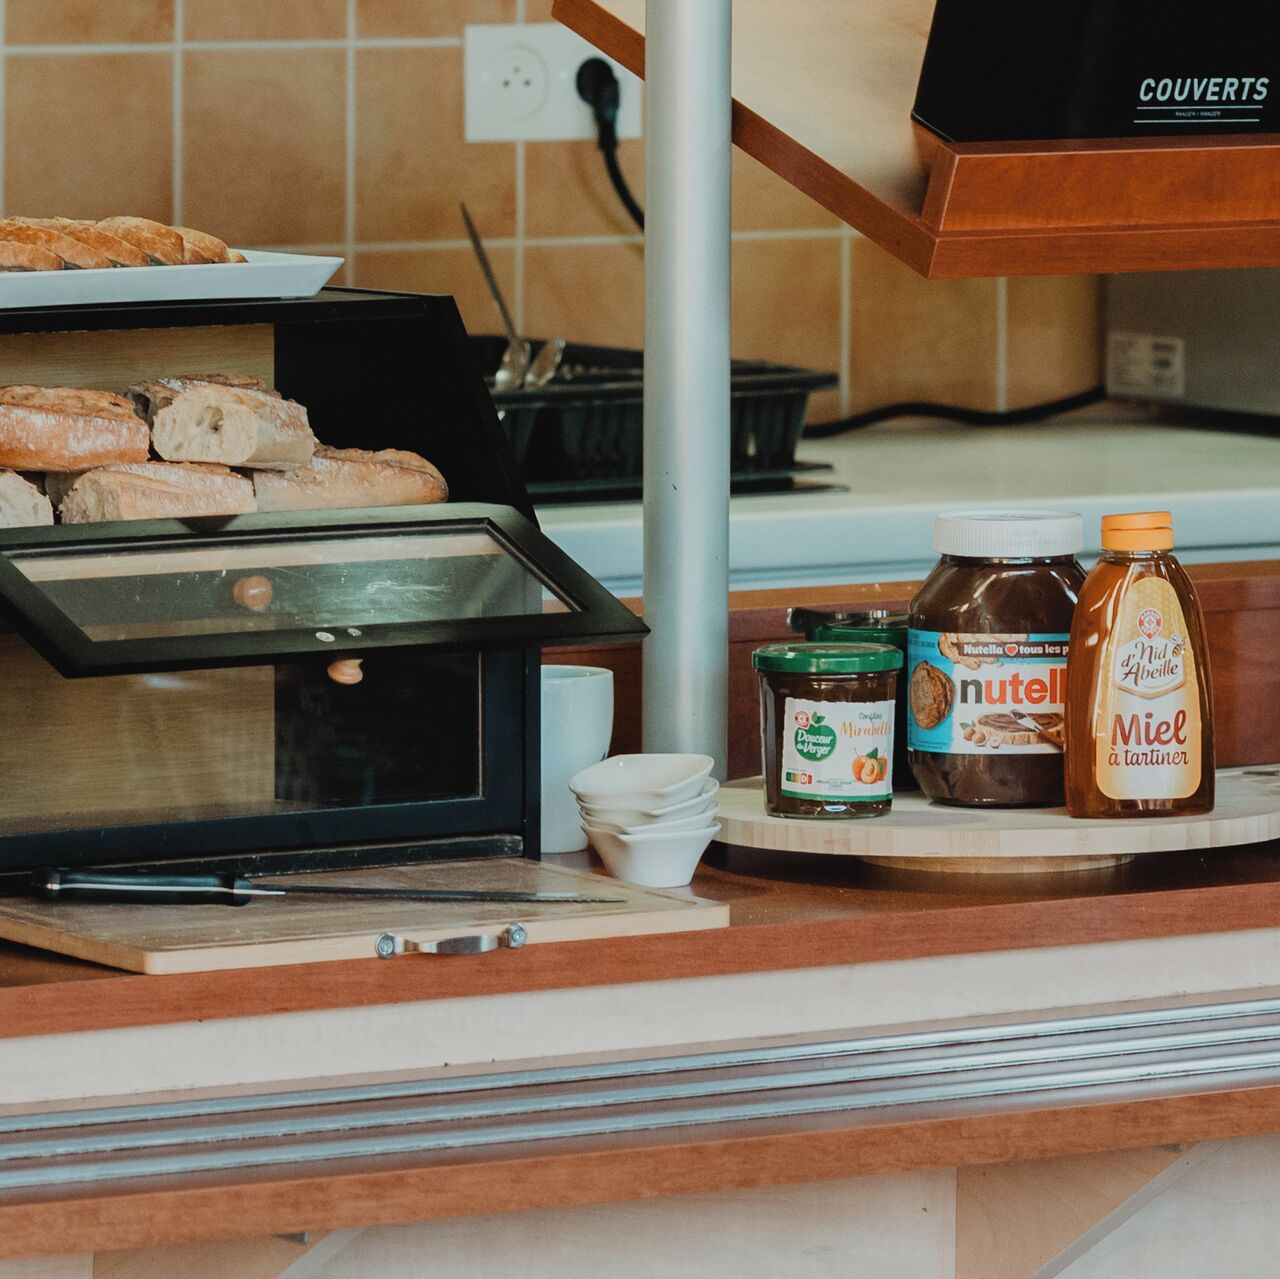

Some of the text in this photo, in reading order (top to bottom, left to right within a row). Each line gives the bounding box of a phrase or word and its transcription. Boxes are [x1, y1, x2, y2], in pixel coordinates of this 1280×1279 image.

[1139, 77, 1270, 102] COUVERTS
[964, 644, 1003, 655] Nutella
[1019, 644, 1044, 655] tous
[1045, 644, 1061, 654] les
[1134, 641, 1169, 664] Nid
[1120, 659, 1179, 687] Abeille
[960, 668, 1067, 705] nutell
[797, 729, 834, 745] Douceur
[1111, 709, 1187, 746] Miel
[803, 742, 832, 758] Verger
[1108, 746, 1189, 767] à tartiner
